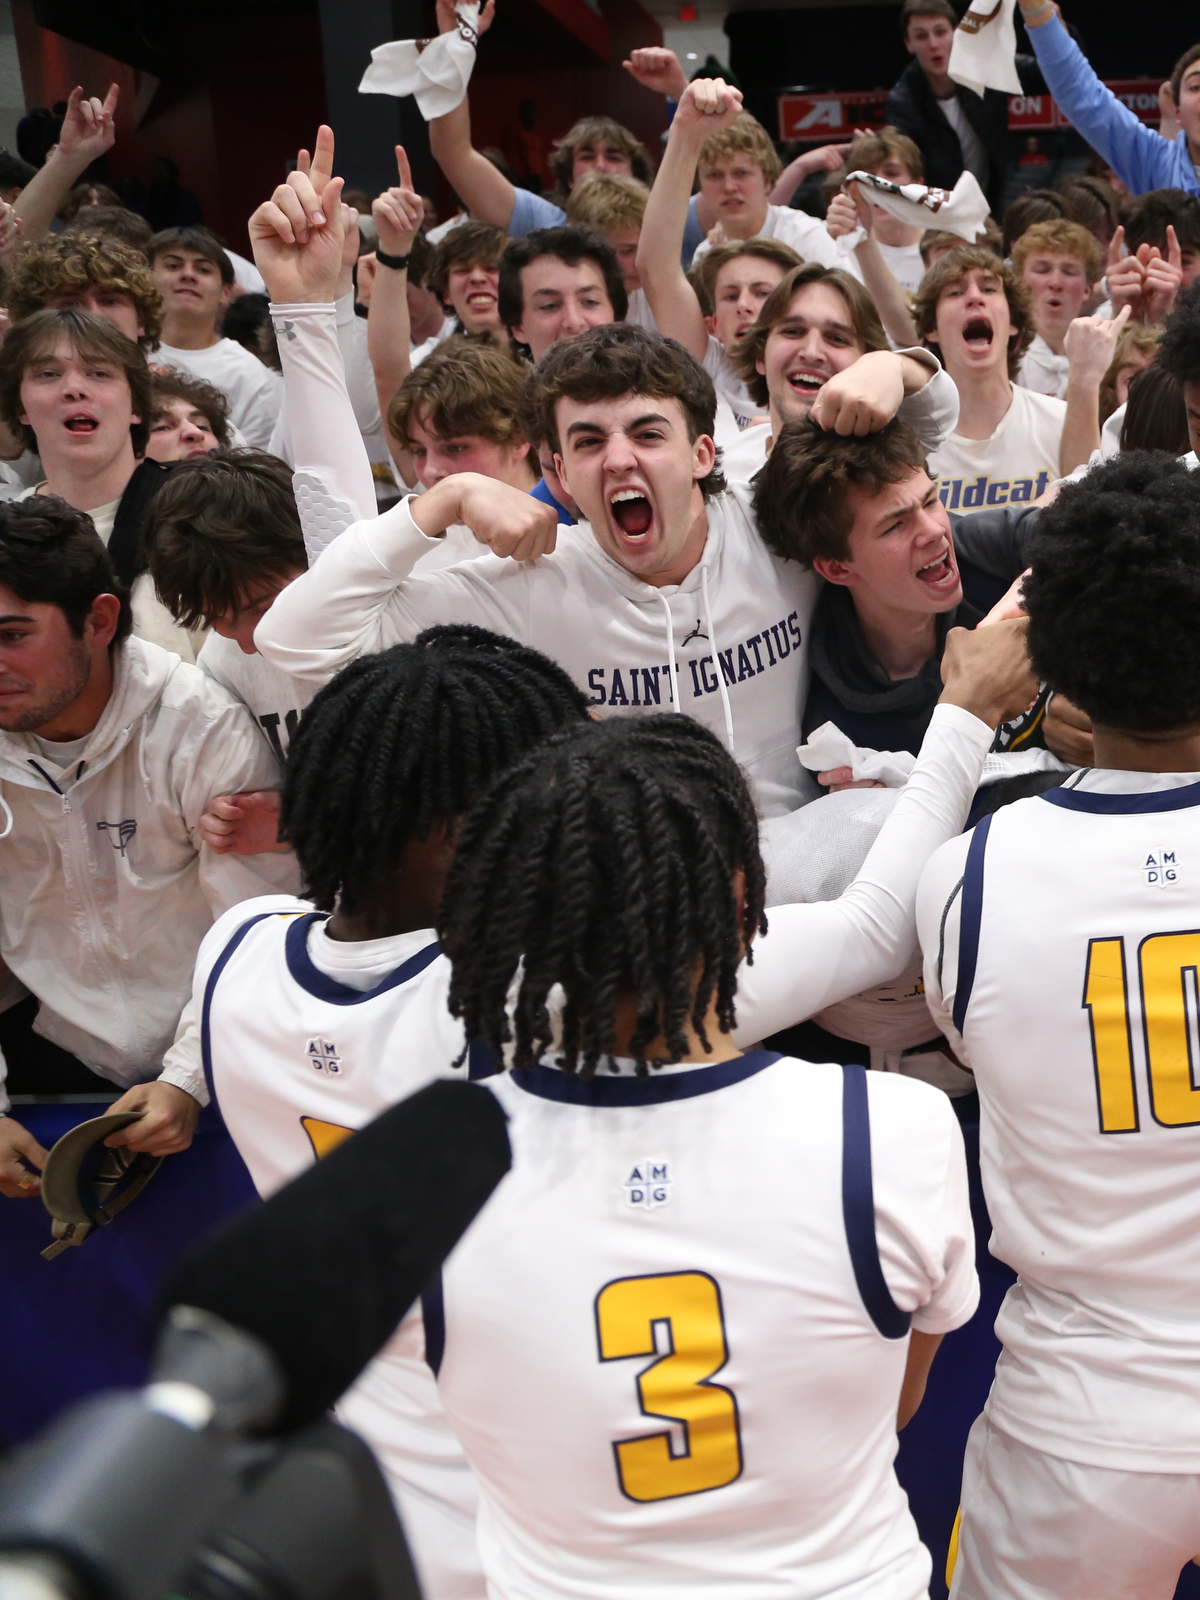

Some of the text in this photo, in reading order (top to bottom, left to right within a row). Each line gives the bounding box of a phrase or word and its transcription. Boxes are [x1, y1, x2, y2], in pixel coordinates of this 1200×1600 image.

[932, 470, 1049, 510] ildcat
[588, 610, 803, 706] SAINT IGNATIUS
[592, 1269, 744, 1503] 3
